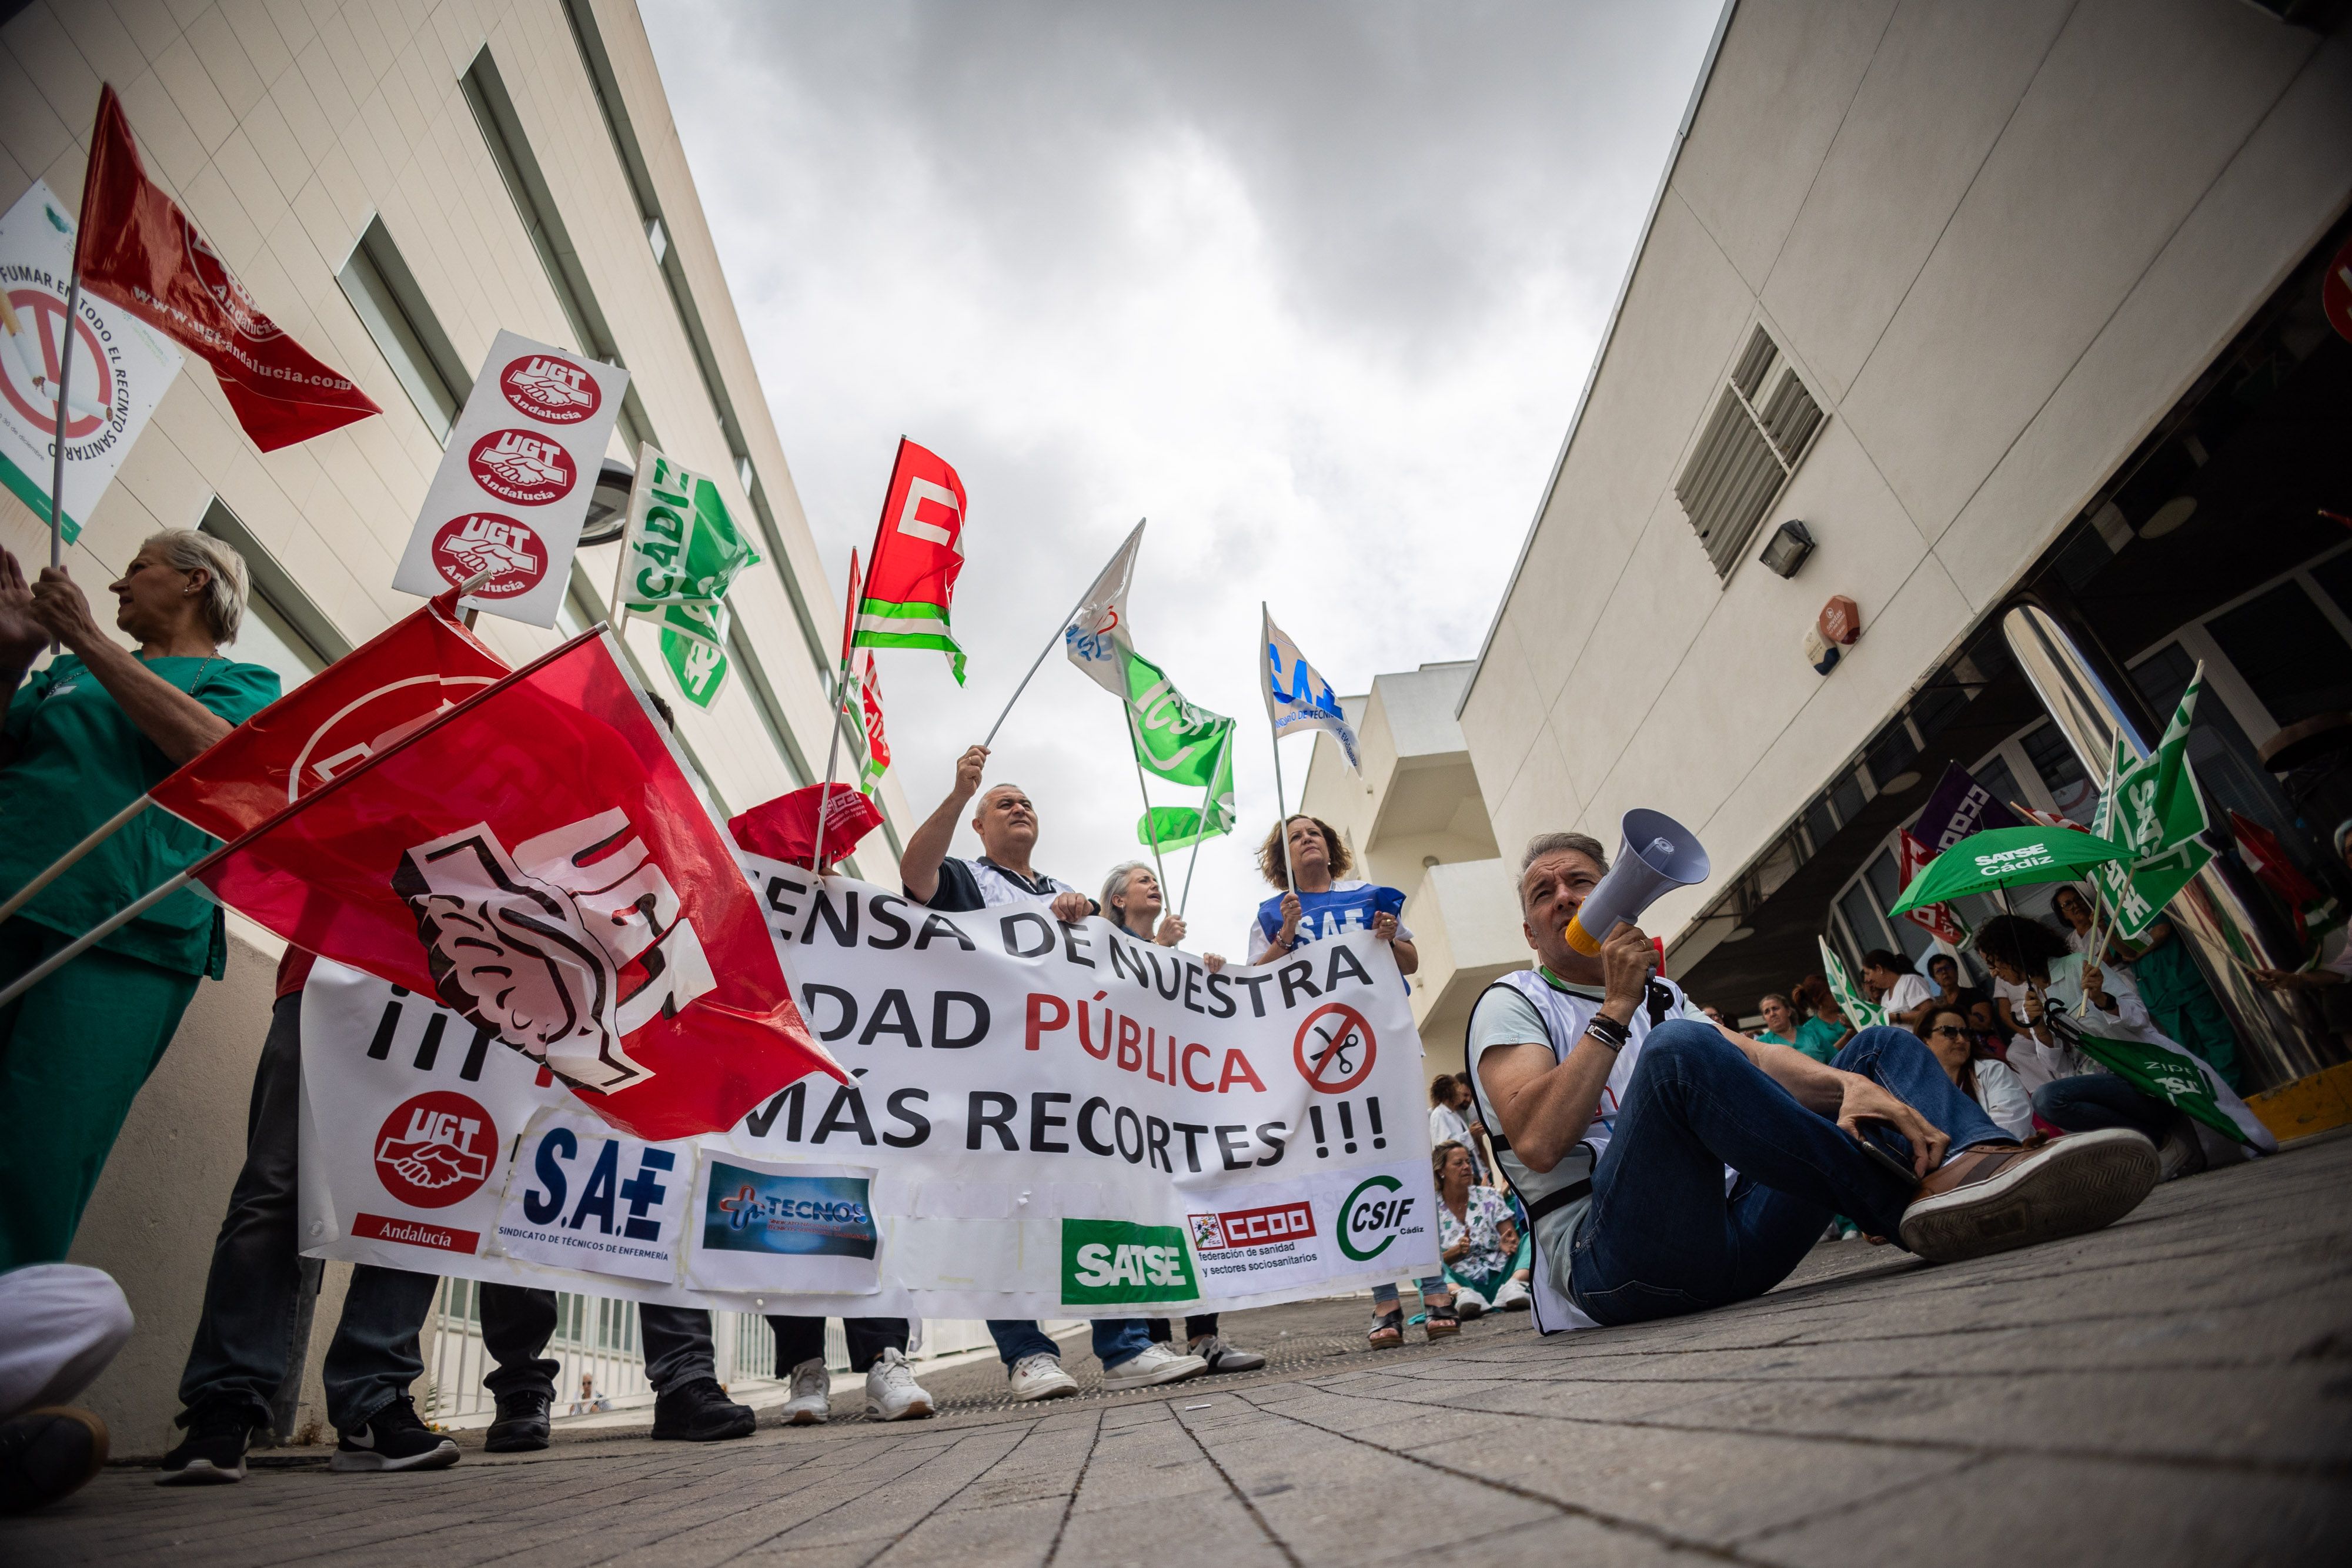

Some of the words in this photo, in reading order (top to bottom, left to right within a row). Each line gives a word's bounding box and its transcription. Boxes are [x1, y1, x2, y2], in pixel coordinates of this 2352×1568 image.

[0, 265, 53, 289] FUMAR
[79, 298, 112, 342] TODO
[133, 285, 353, 390] www.ugt-andalucia.com
[108, 346, 122, 365] EL
[525, 357, 587, 390] UGT
[112, 368, 129, 433] RECINTO
[18, 433, 45, 462] diciembre
[48, 430, 117, 462] SANITARO
[495, 432, 561, 466] UGT
[460, 516, 531, 553] UGT
[633, 457, 689, 600] CÁDIZ
[1975, 842, 2049, 867] SATSE
[1980, 855, 2054, 876] Cádiz
[1000, 912, 1096, 969] DE
[1109, 934, 1374, 1018] NUESTRA
[1024, 990, 1268, 1094] PÚBLICA
[405, 1108, 481, 1153] UGT
[744, 1068, 931, 1148] MÁS
[965, 1090, 1287, 1174] RECORTES
[1309, 1096, 1388, 1158] !!!
[766, 1195, 868, 1225] TECNOS
[1225, 1209, 1309, 1241] CCOO
[1352, 1198, 1416, 1233] CSIF
[379, 1222, 452, 1248] Andalucía
[498, 1226, 547, 1242] SINDICATO
[547, 1235, 560, 1245] DE
[562, 1236, 604, 1251] TÉCNICOS
[606, 1244, 617, 1254] DE
[619, 1246, 669, 1262] ENFERMERÍA
[1400, 1226, 1425, 1235] Cádiz
[1074, 1243, 1187, 1288] SATSE
[1198, 1248, 1245, 1261] federación
[1247, 1248, 1258, 1257] de
[1259, 1242, 1295, 1255] sanidad
[1202, 1268, 1208, 1278] y
[1210, 1263, 1247, 1275] sectores
[1248, 1253, 1318, 1271] sociosanitarios
